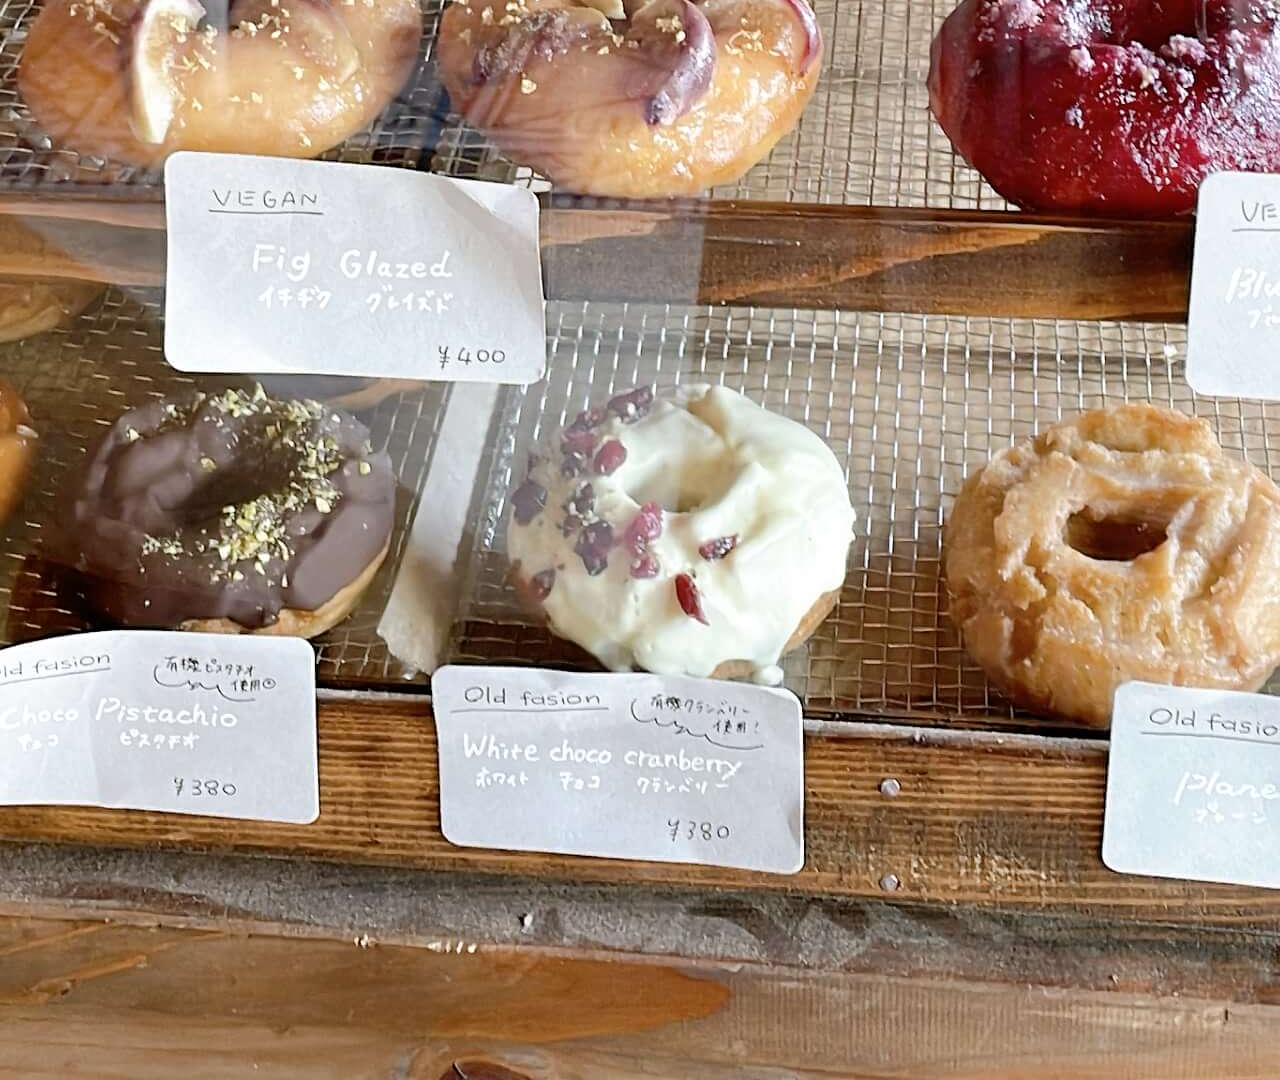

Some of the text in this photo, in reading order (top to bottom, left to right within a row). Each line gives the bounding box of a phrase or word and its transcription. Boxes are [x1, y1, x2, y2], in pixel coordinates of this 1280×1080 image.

[211, 189, 318, 208] VEGAN
[252, 244, 453, 282] Fig Glazed
[365, 285, 453, 316] グレイズド
[438, 345, 506, 369] ¥400
[34, 653, 112, 677] fasion
[464, 686, 602, 707] Old fasion
[0, 696, 239, 730] Choco Pistachio
[1148, 707, 1195, 728] Old
[463, 732, 742, 781] White choco cranberry
[668, 818, 730, 842] ¥380
